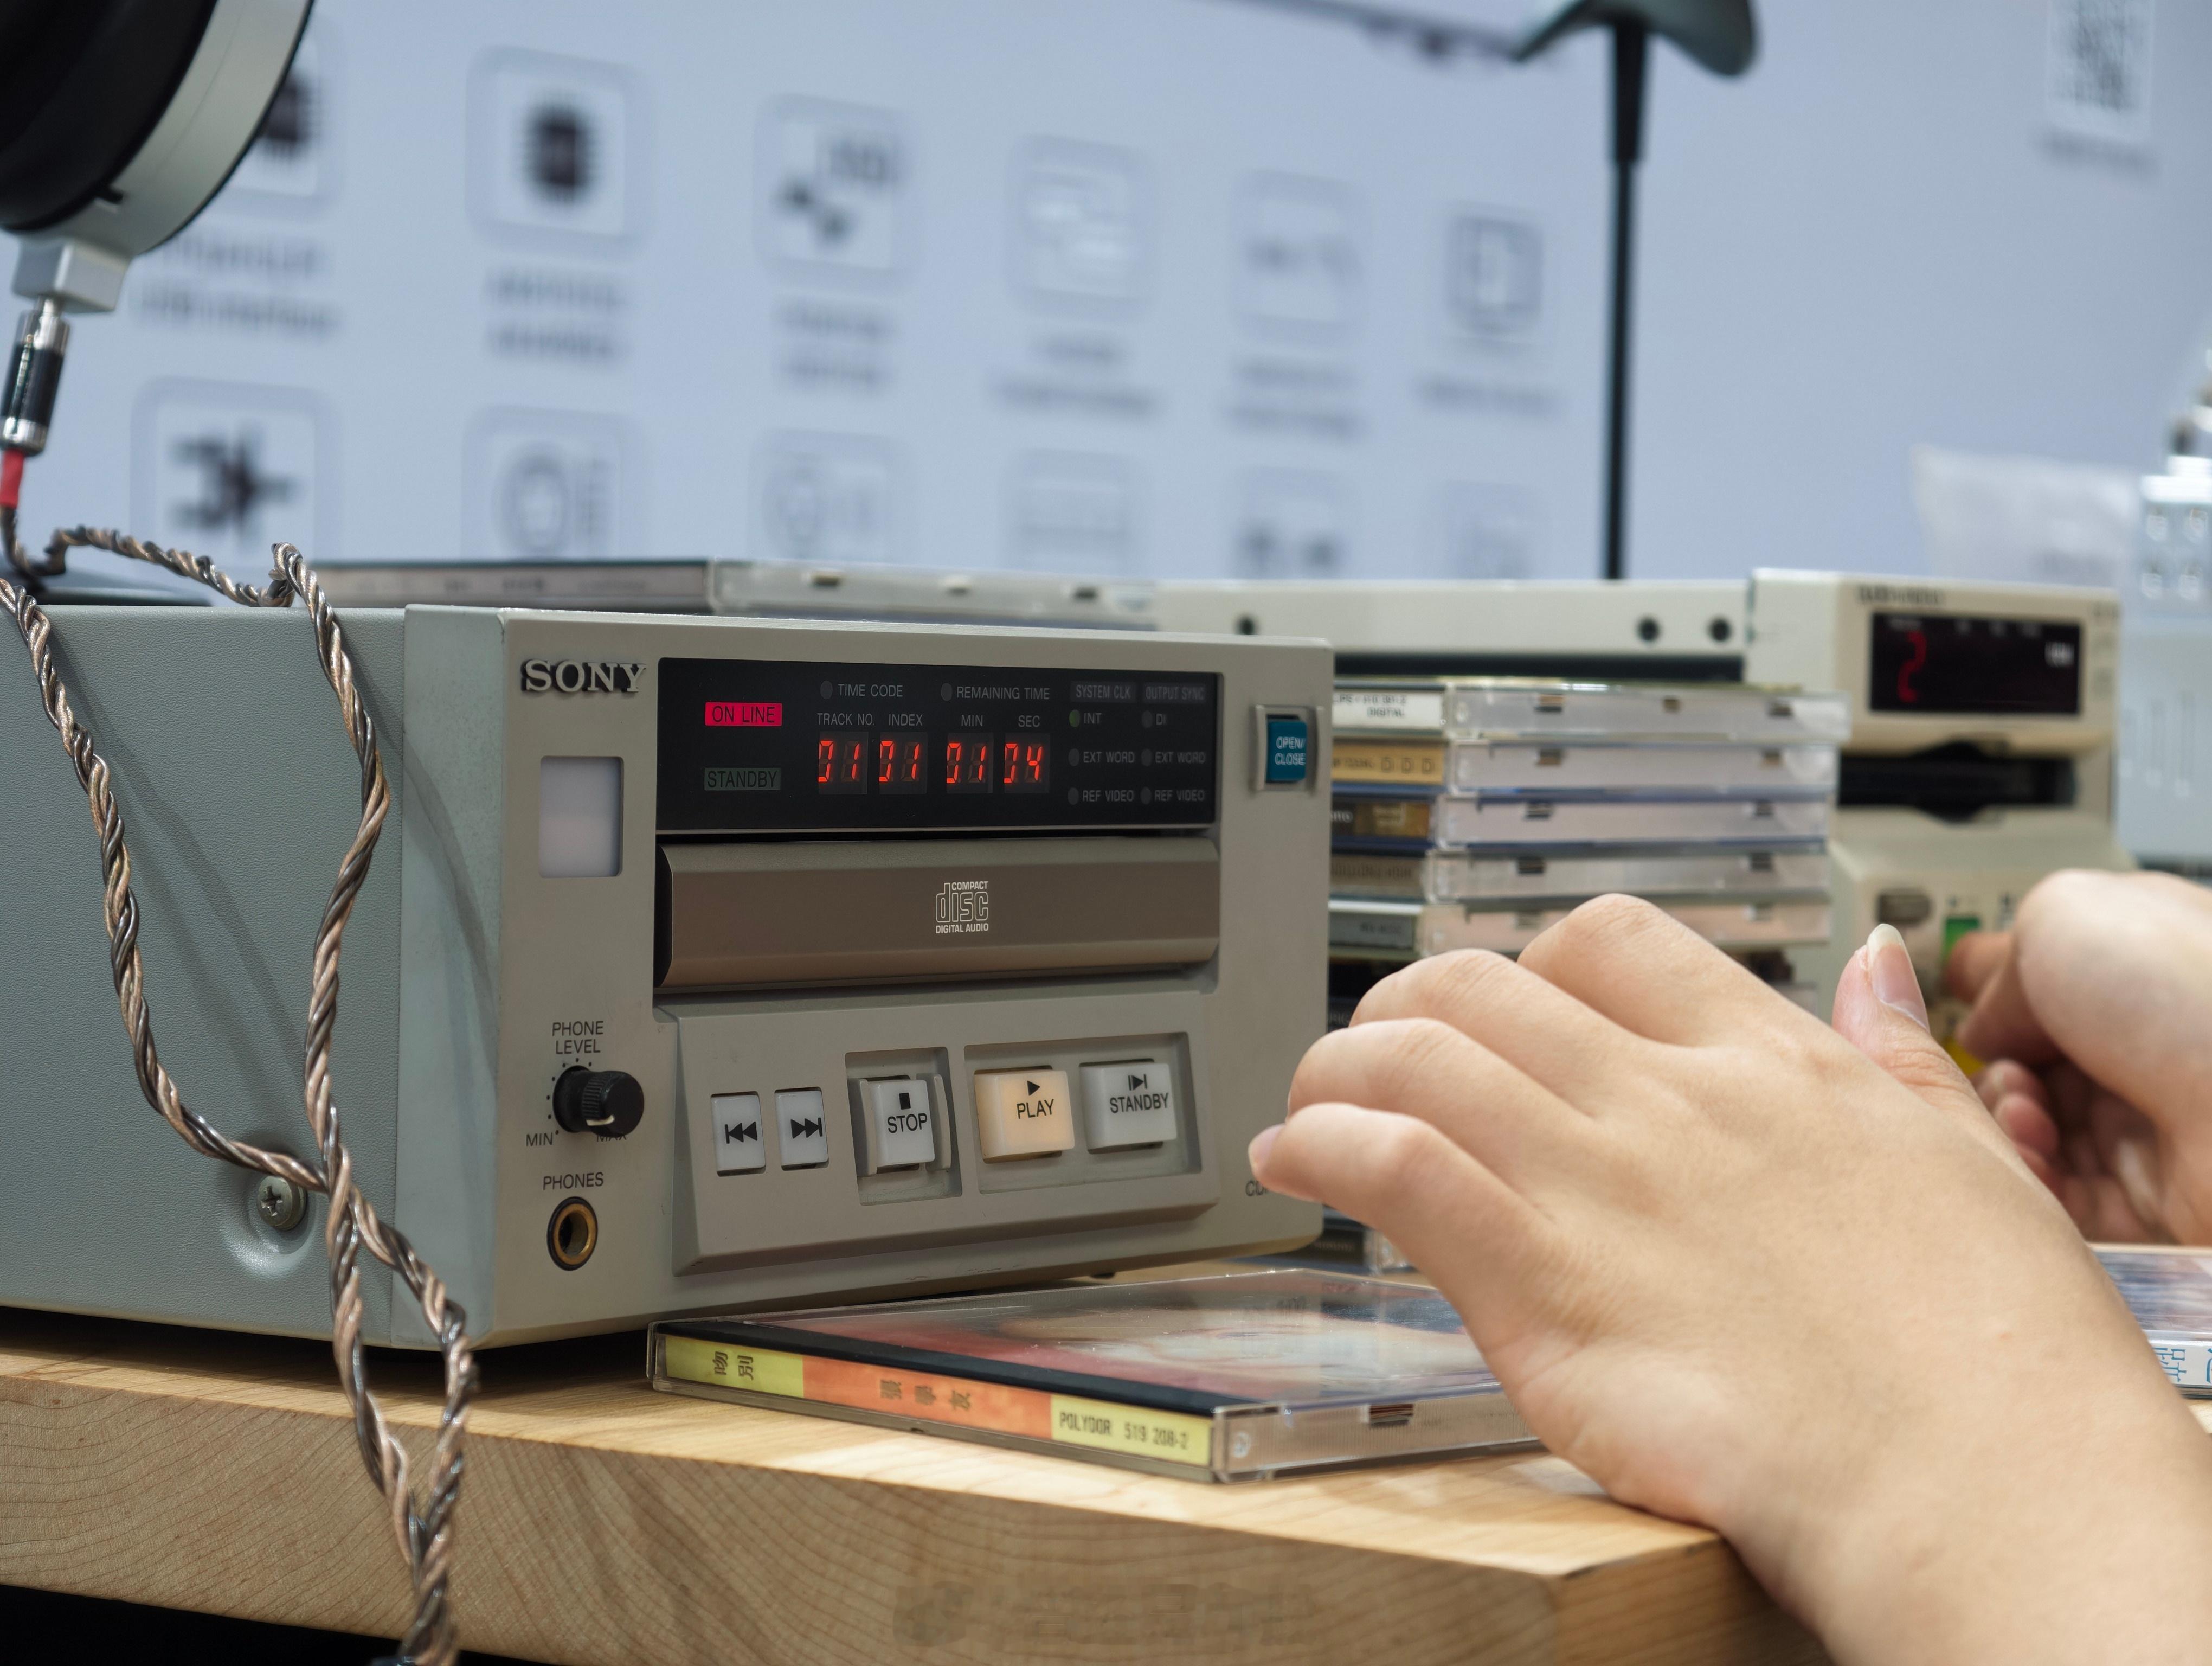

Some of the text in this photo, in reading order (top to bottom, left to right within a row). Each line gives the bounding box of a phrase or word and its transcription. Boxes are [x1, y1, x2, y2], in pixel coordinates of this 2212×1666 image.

[522, 658, 647, 693] SONY
[838, 684, 903, 697] TIME CODE
[956, 687, 1050, 700] REMAINING TIME
[1076, 684, 1131, 700] SYSTEM CLK
[1145, 687, 1205, 701] OUTPUT SYNC
[712, 706, 775, 723] ON LINE
[817, 713, 874, 726] TRACK NO.
[889, 714, 923, 726] INDEX
[961, 715, 983, 727] MIN
[1018, 715, 1040, 728] SEC
[1084, 713, 1102, 725] INT
[1083, 751, 1135, 764] EXT WORD
[1155, 751, 1206, 765] EXT WORD
[1275, 753, 1306, 766] CLOSE
[707, 771, 777, 788] STANDBY
[1083, 790, 1134, 802] REF VIDEO
[1154, 789, 1205, 802] REF VIDEO
[951, 881, 989, 890] COMPACT
[935, 882, 988, 923] disc
[936, 923, 989, 934] DIGITAL AUDIO
[552, 1020, 604, 1036] PHONE
[556, 1039, 601, 1055] LEVEL
[1016, 1099, 1054, 1119] PLAY
[1110, 1092, 1169, 1113] STANDBY
[887, 1113, 928, 1133] STOP
[525, 1132, 553, 1147] MIN
[543, 1171, 604, 1190] PHONES
[1059, 1412, 1189, 1450] POLYDOR 519 208-2
